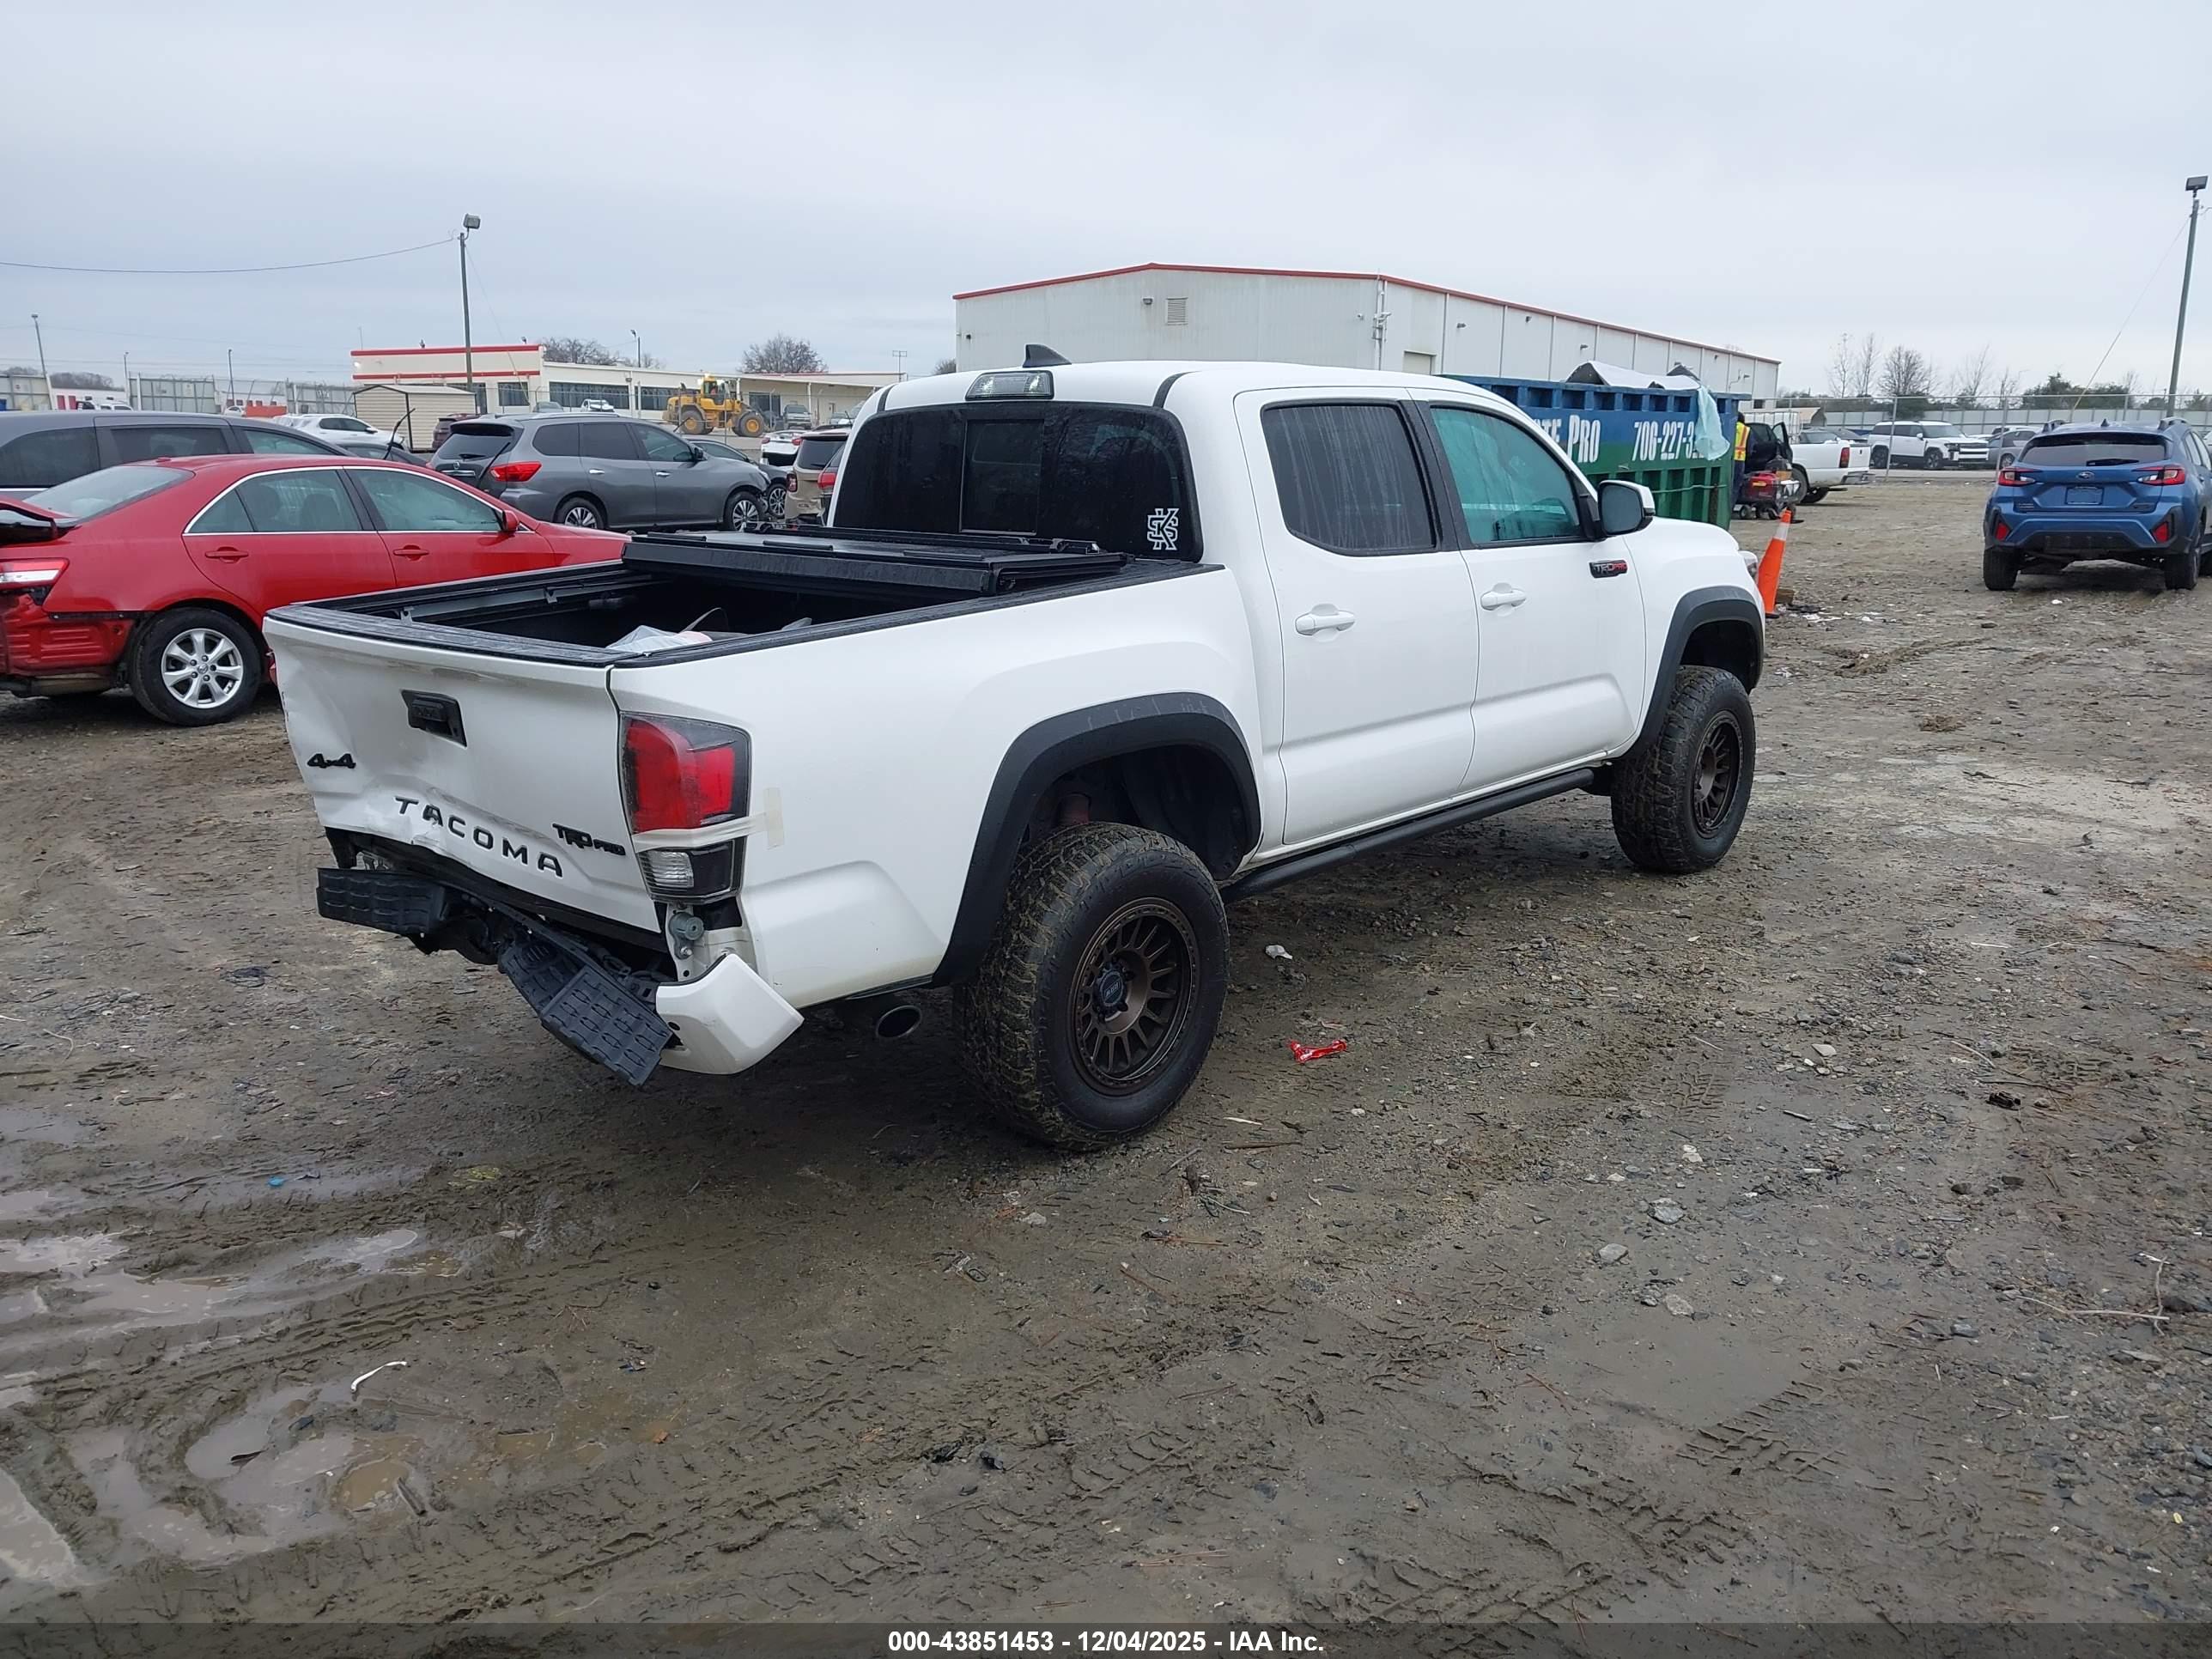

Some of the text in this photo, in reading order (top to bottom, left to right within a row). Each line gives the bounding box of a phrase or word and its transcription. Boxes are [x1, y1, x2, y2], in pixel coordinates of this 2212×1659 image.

[1567, 415, 1601, 464] PRO
[1632, 420, 1705, 461] 706-227-3
[394, 795, 563, 878] TACOMA
[551, 823, 592, 848] TRD
